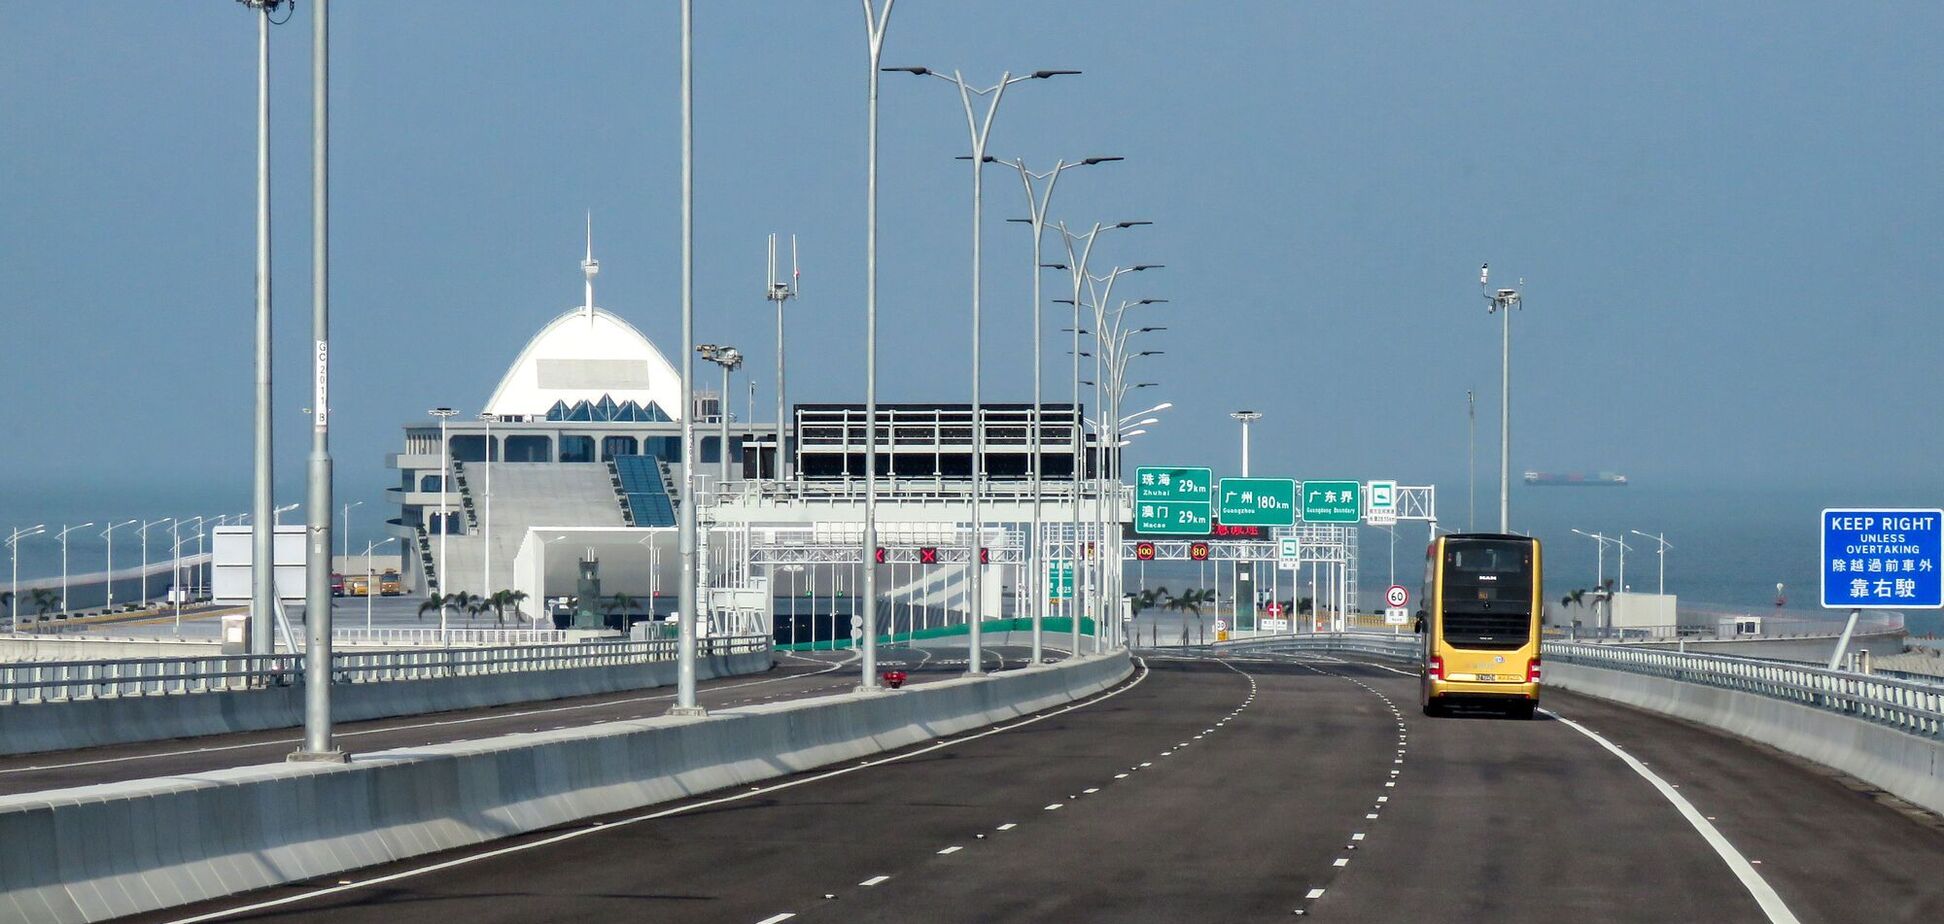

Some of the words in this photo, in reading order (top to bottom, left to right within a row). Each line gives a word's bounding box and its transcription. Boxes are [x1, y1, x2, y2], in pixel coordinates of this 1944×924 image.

[1142, 473, 1171, 486] 珠海
[1225, 491, 1253, 504] 广州
[1308, 490, 1353, 504] 广东界
[1142, 505, 1169, 519] 澳门
[1832, 517, 1875, 531] KEEP
[1882, 517, 1934, 531] RIGHT
[1860, 534, 1906, 543] UNLESS
[1138, 548, 1152, 556] 100
[1193, 548, 1206, 556] 80
[1846, 545, 1920, 554] OVERTAKING
[1832, 558, 1933, 572] 除越過前車外
[1849, 578, 1916, 598] 靠右駛
[1391, 592, 1403, 601] 60
